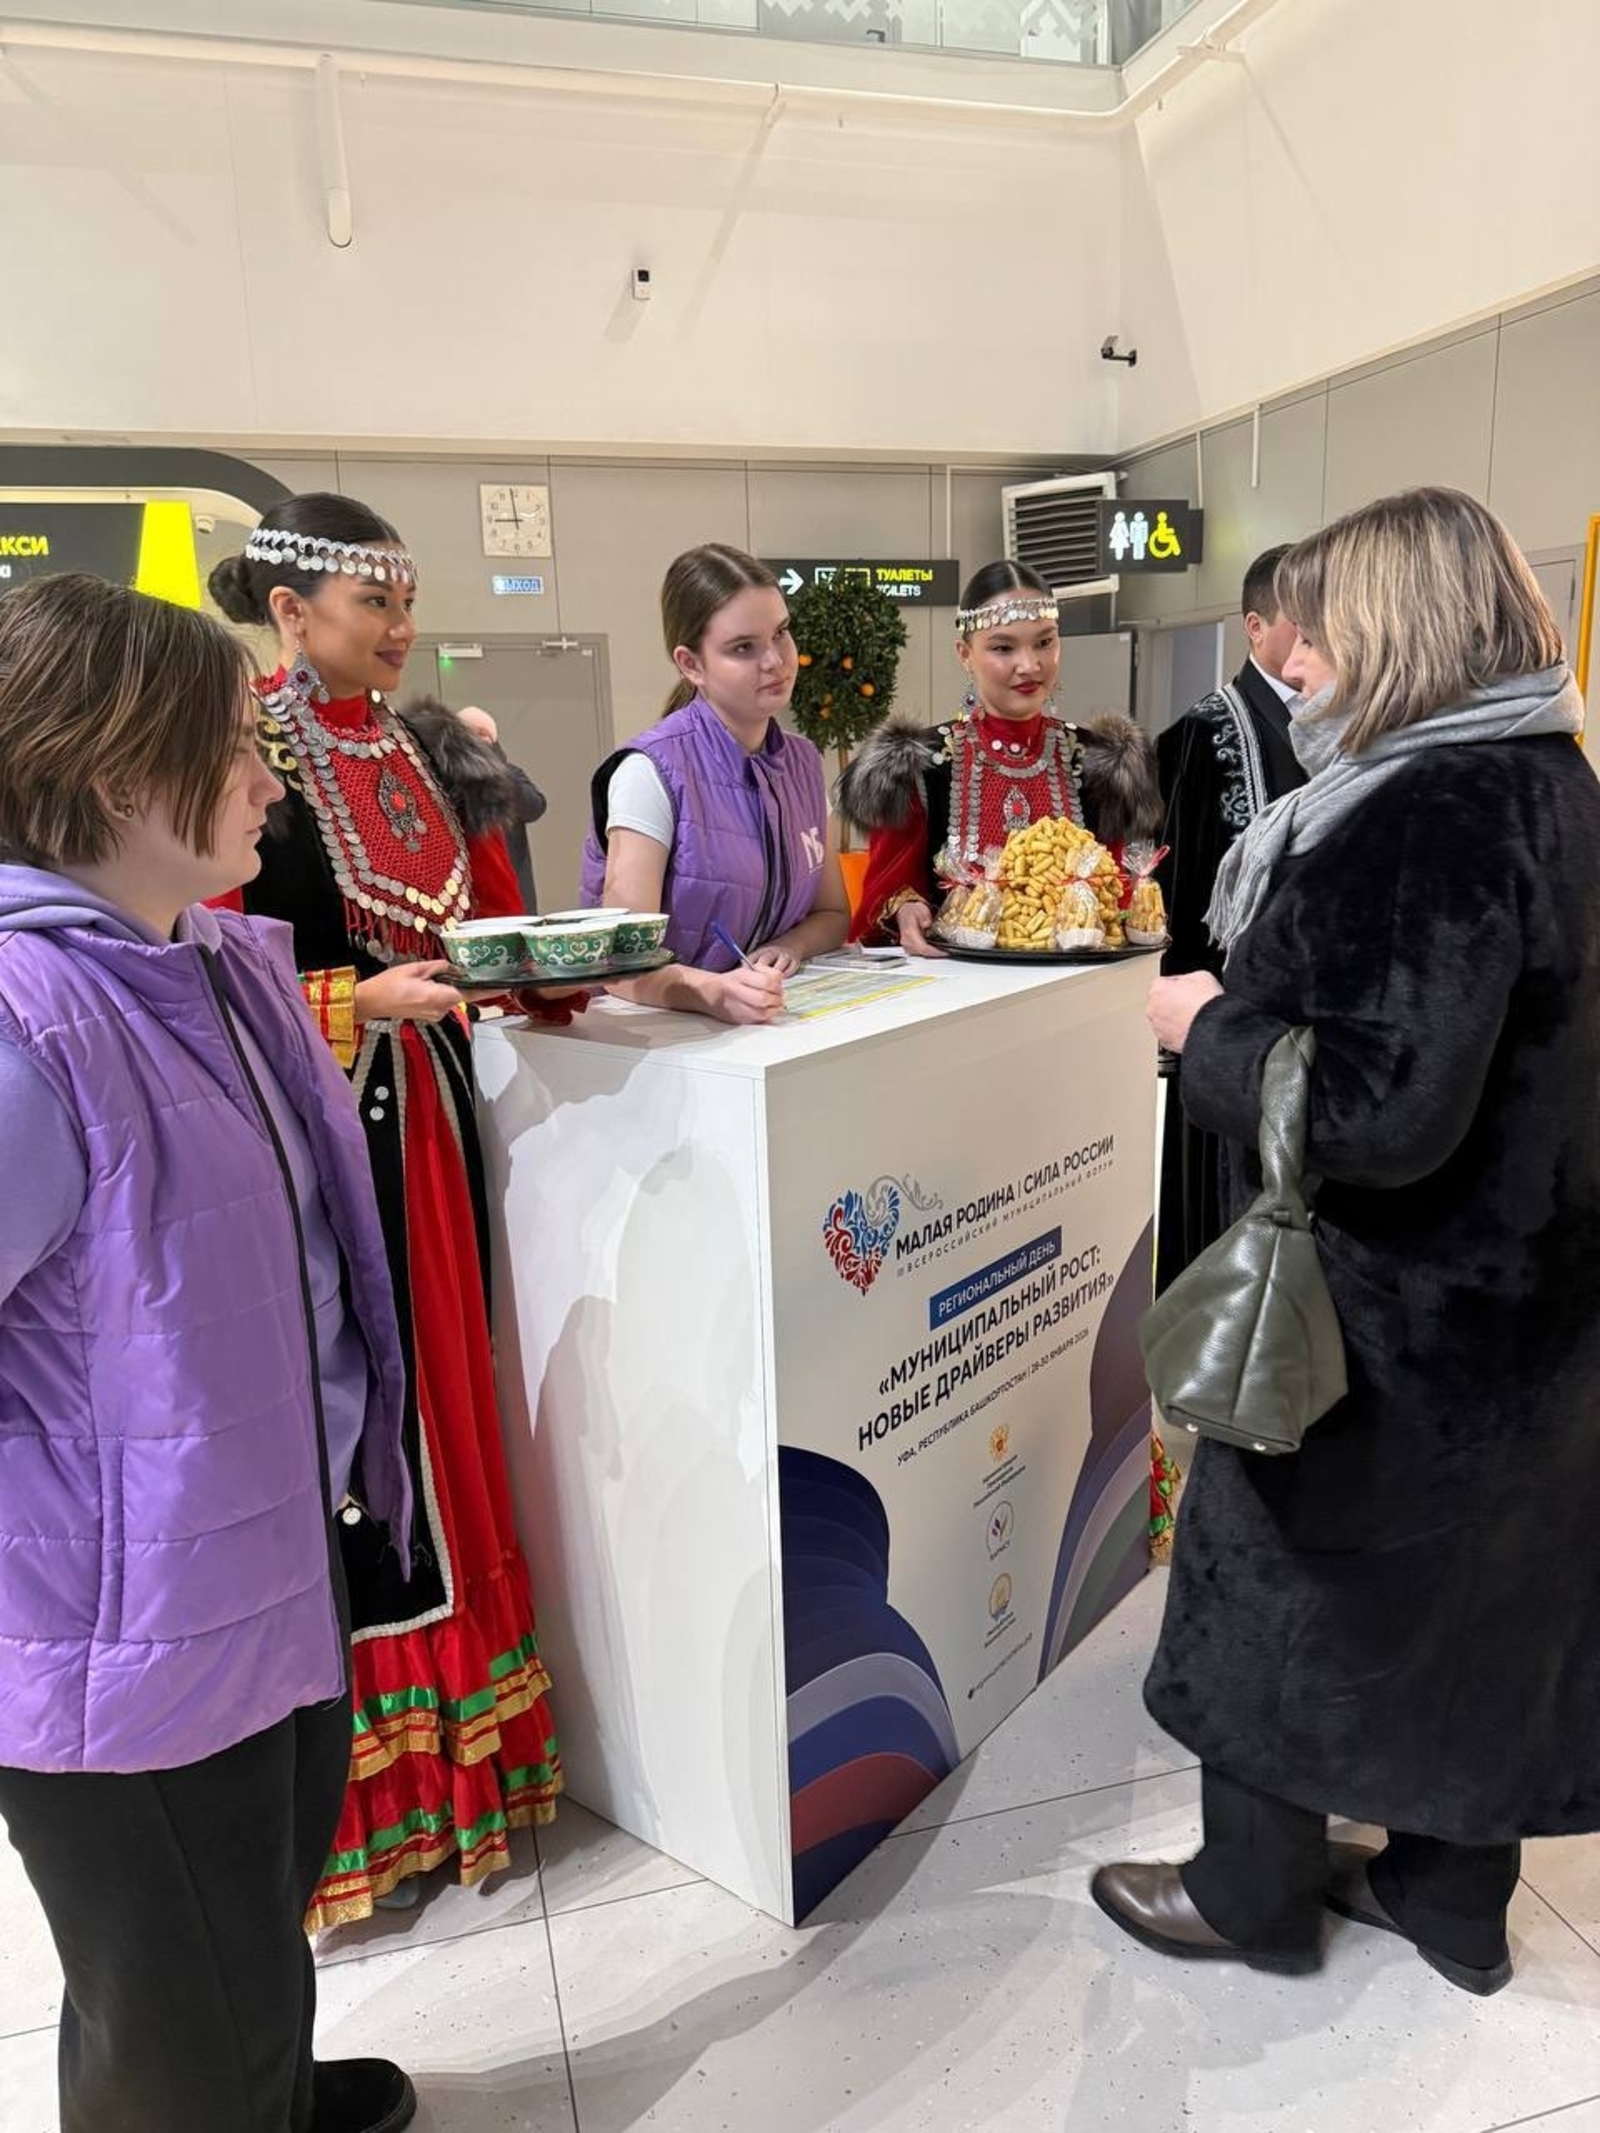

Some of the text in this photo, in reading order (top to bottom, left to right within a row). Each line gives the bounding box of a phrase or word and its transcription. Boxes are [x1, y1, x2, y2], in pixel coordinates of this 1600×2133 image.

[0, 535, 49, 556] КСИ
[876, 569, 933, 581] ТУАЛЕТЫ
[496, 578, 539, 591] ЫХОД
[896, 1134, 1114, 1260] МАЛАЯ РОДИНА СИЛА РОССИИ
[908, 1217, 998, 1272] ВСЕРОССИЙСКИЙ
[938, 1241, 1056, 1317] РЕГИОНАЛЬНЫЙ ДЕНЬ
[879, 1244, 1101, 1396] «МУНИЦИПАЛЬНЫЙ РОСТ:
[858, 1272, 1114, 1451] НОВЫЕ ДРАЙВЕРЫ РАЗВИТИЯ»
[897, 1447, 917, 1466] УФА,
[918, 1409, 969, 1452] РЕСПУБЛИКА
[969, 1371, 1027, 1415] БАШКОРТОСТАН
[1050, 1337, 1074, 1359] ЯНВАРЯ
